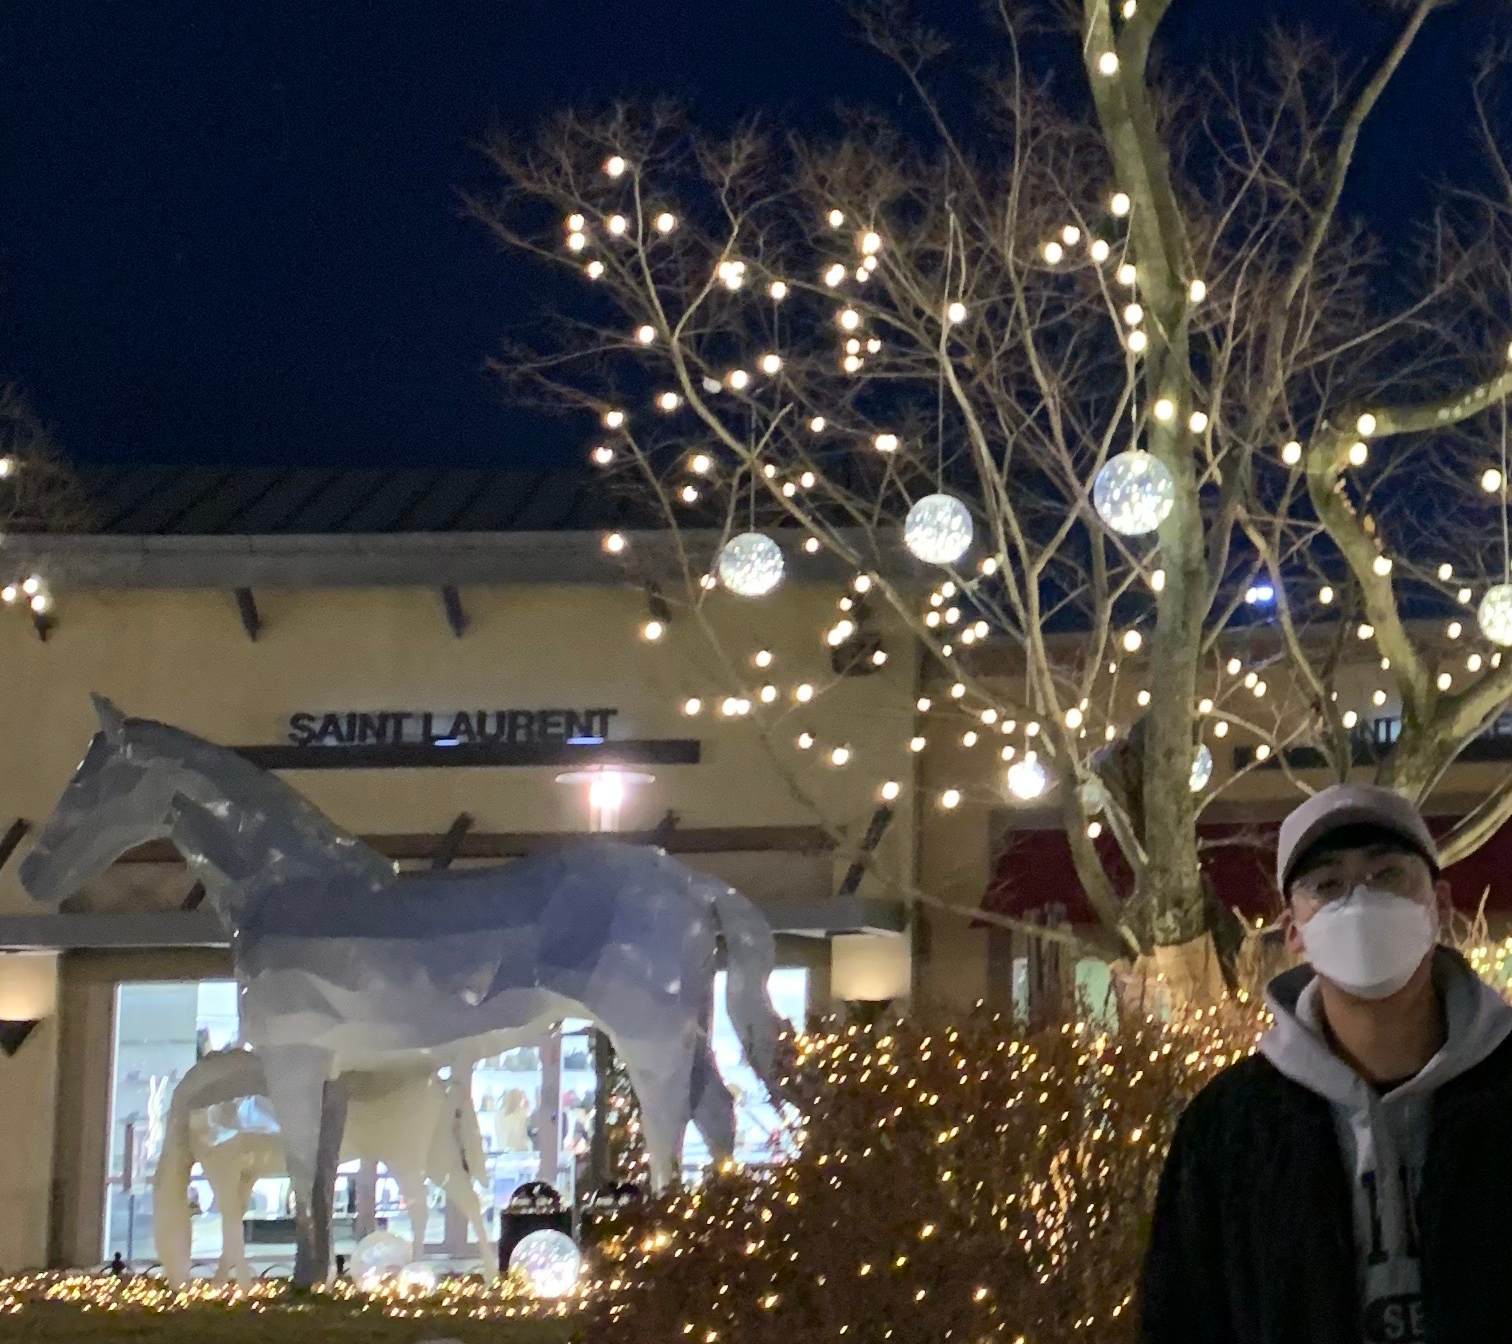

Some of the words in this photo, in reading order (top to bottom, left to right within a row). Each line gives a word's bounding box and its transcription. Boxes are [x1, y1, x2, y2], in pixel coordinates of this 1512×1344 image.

[288, 711, 413, 747] SAINT
[422, 708, 618, 744] LAURENT
[1383, 1302, 1426, 1339] SE
